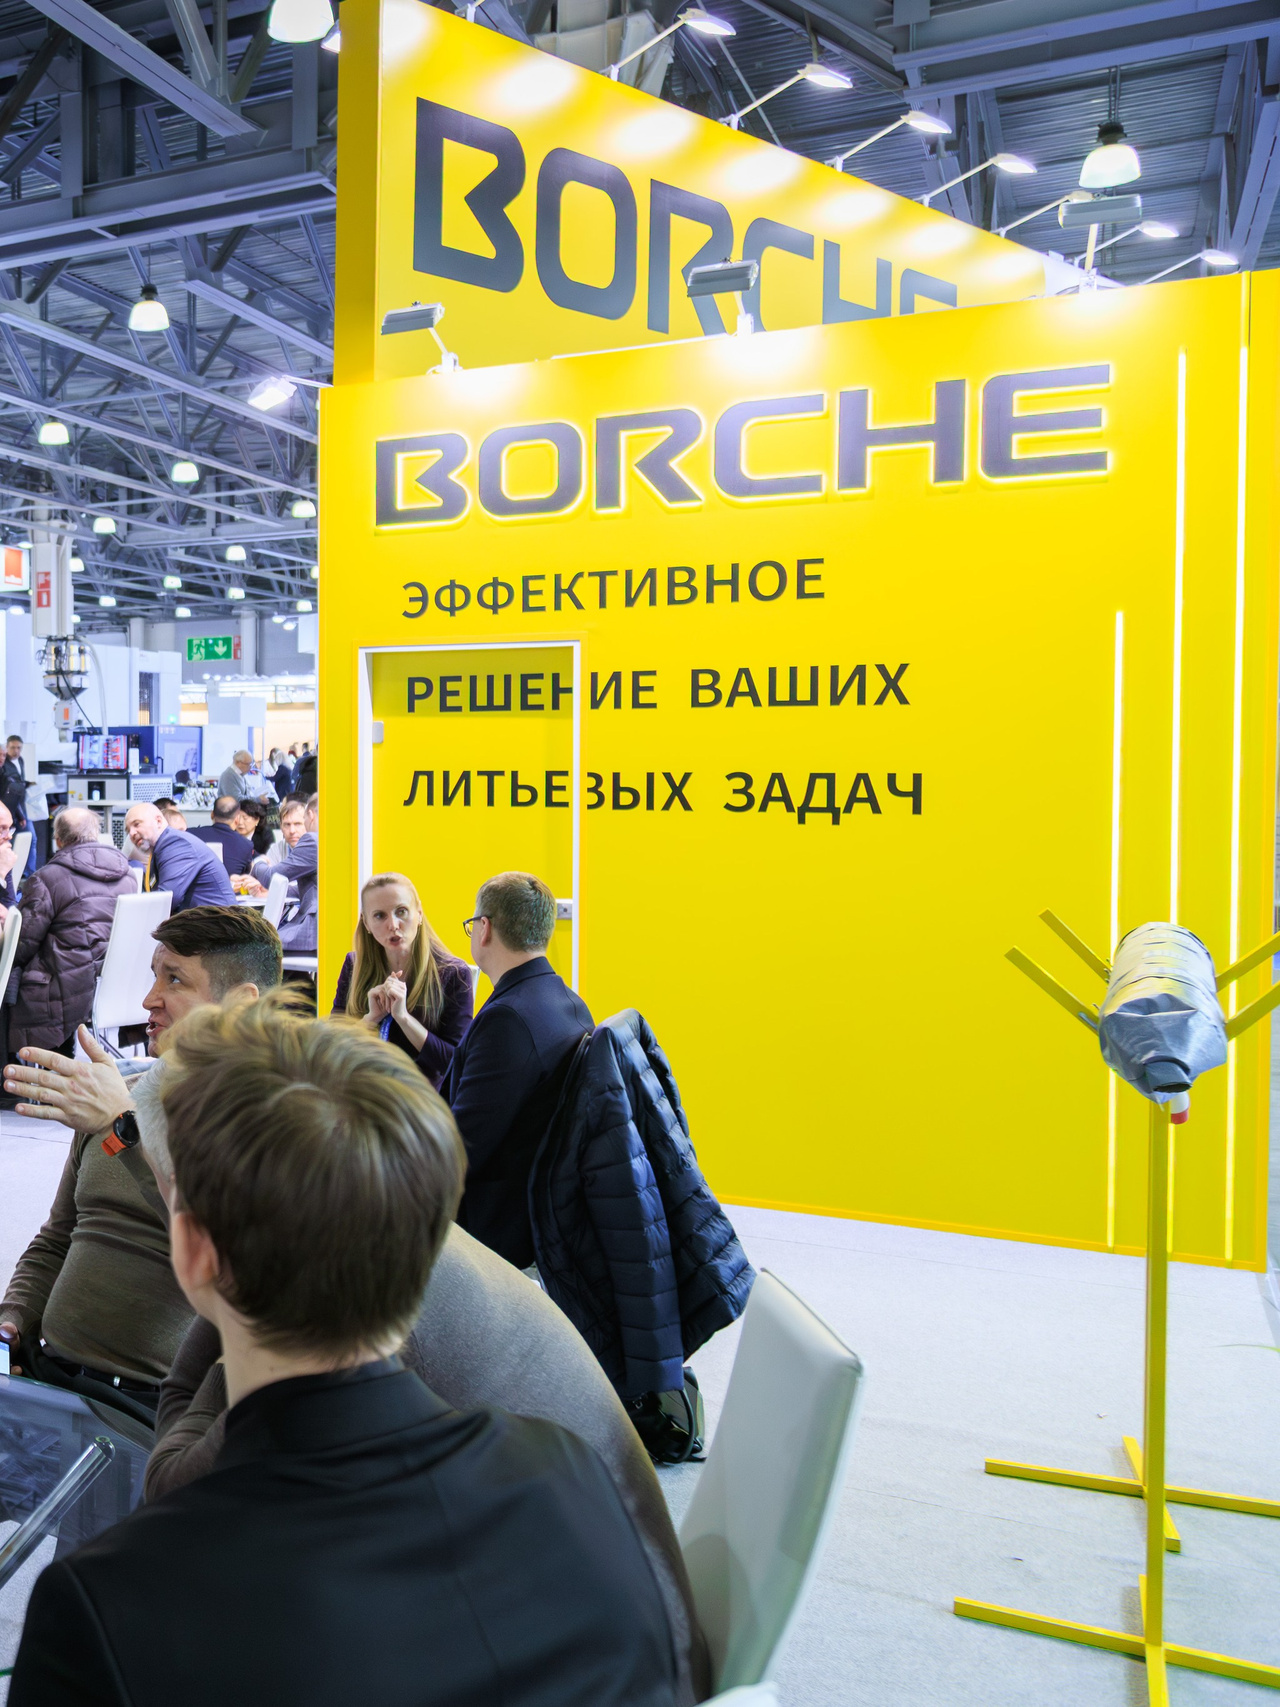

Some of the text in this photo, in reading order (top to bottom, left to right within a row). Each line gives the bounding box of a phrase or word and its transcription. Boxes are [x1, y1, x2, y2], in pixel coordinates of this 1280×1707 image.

[376, 364, 1111, 527] BORCHE
[402, 558, 825, 619] ЭФФЕКТИВНОЕ
[407, 663, 911, 713] РЕШЕНИЕ ВАШИХ
[403, 769, 923, 826] ЛИТЬЕВЫХ ЗАДАЧ
